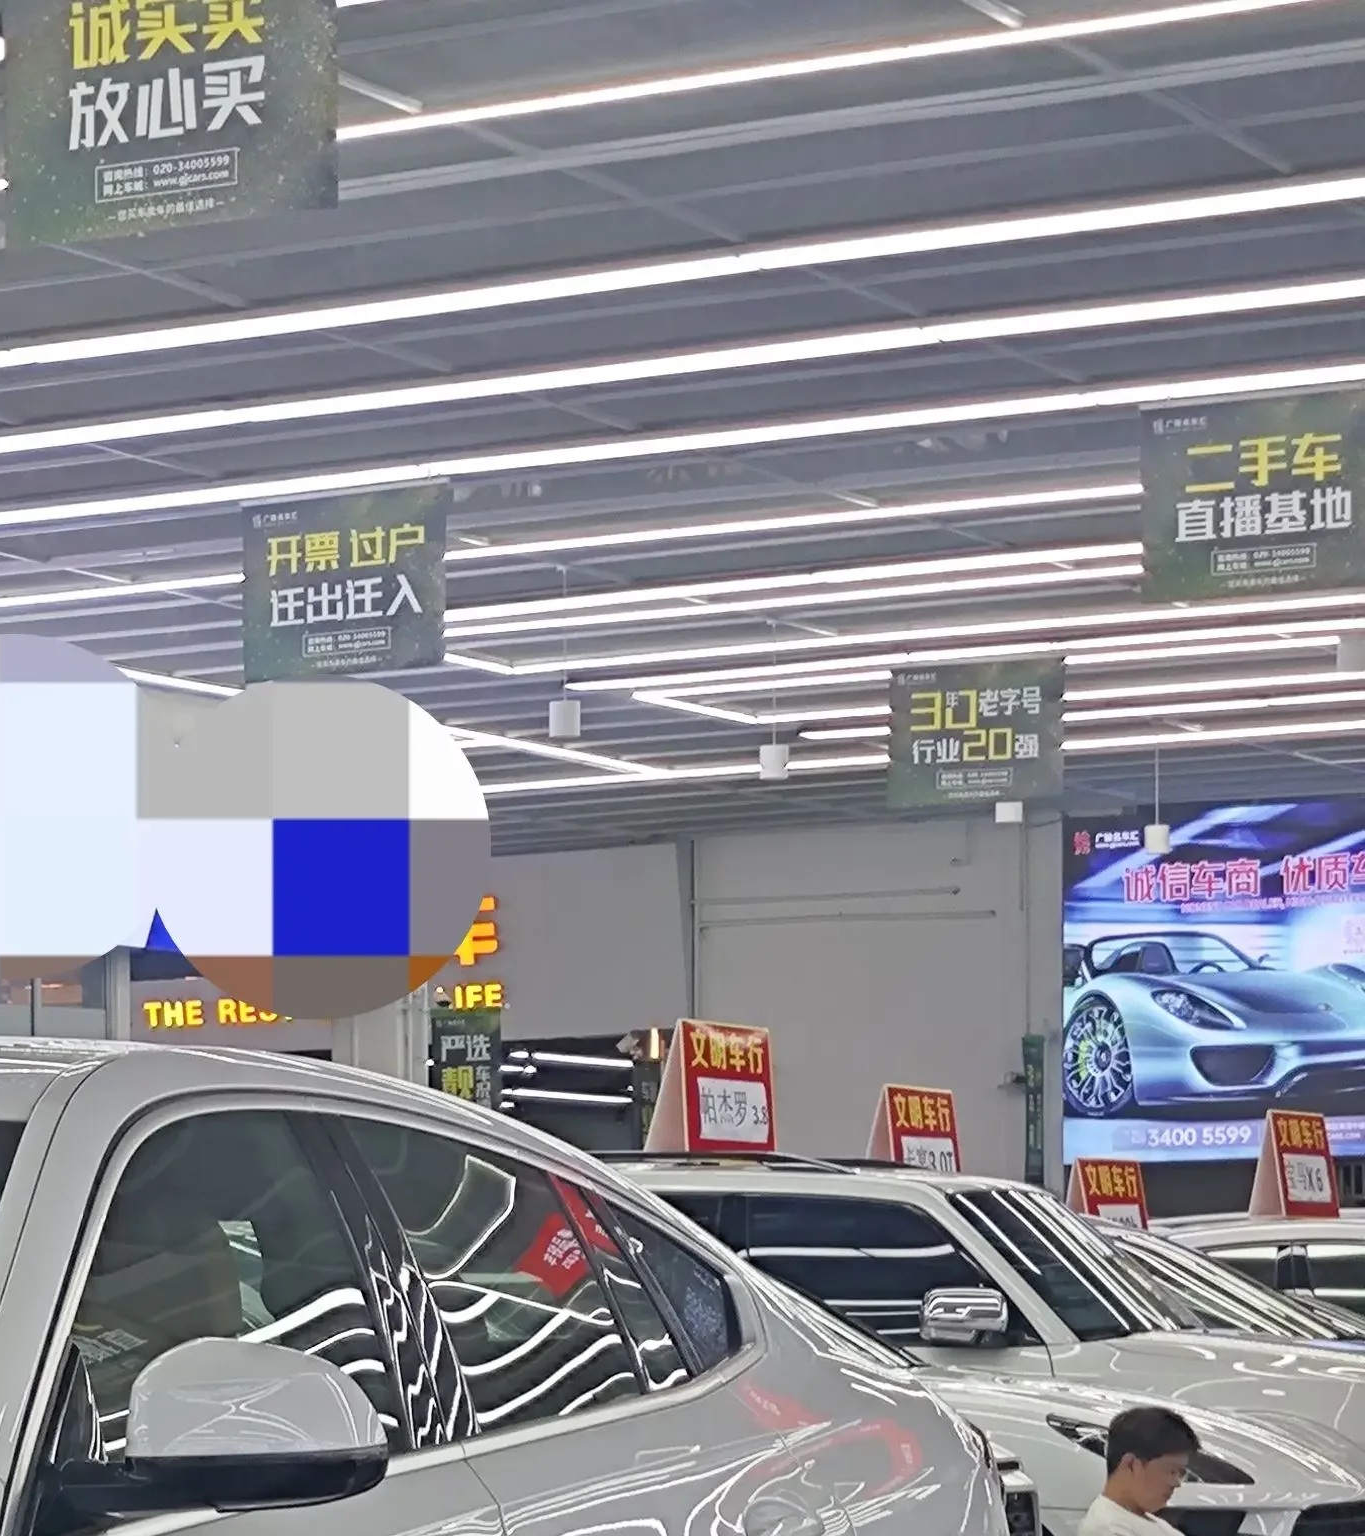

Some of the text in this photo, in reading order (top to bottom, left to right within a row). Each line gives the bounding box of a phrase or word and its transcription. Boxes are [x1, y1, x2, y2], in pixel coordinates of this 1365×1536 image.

[69, 56, 265, 150] 放心买
[1185, 432, 1342, 493] 二手车
[1175, 486, 1352, 542] 直播基地
[267, 523, 425, 576] 开票 过户
[912, 727, 1039, 764] 行业20强
[1124, 858, 1261, 904] 诚信车商
[143, 998, 293, 1028] THE RE
[454, 984, 502, 1009] IFE
[440, 1034, 491, 1062] 严选
[690, 1028, 763, 1074] 文明车行
[893, 1093, 951, 1132] 文明车行
[1147, 1125, 1252, 1146] 3400 5599
